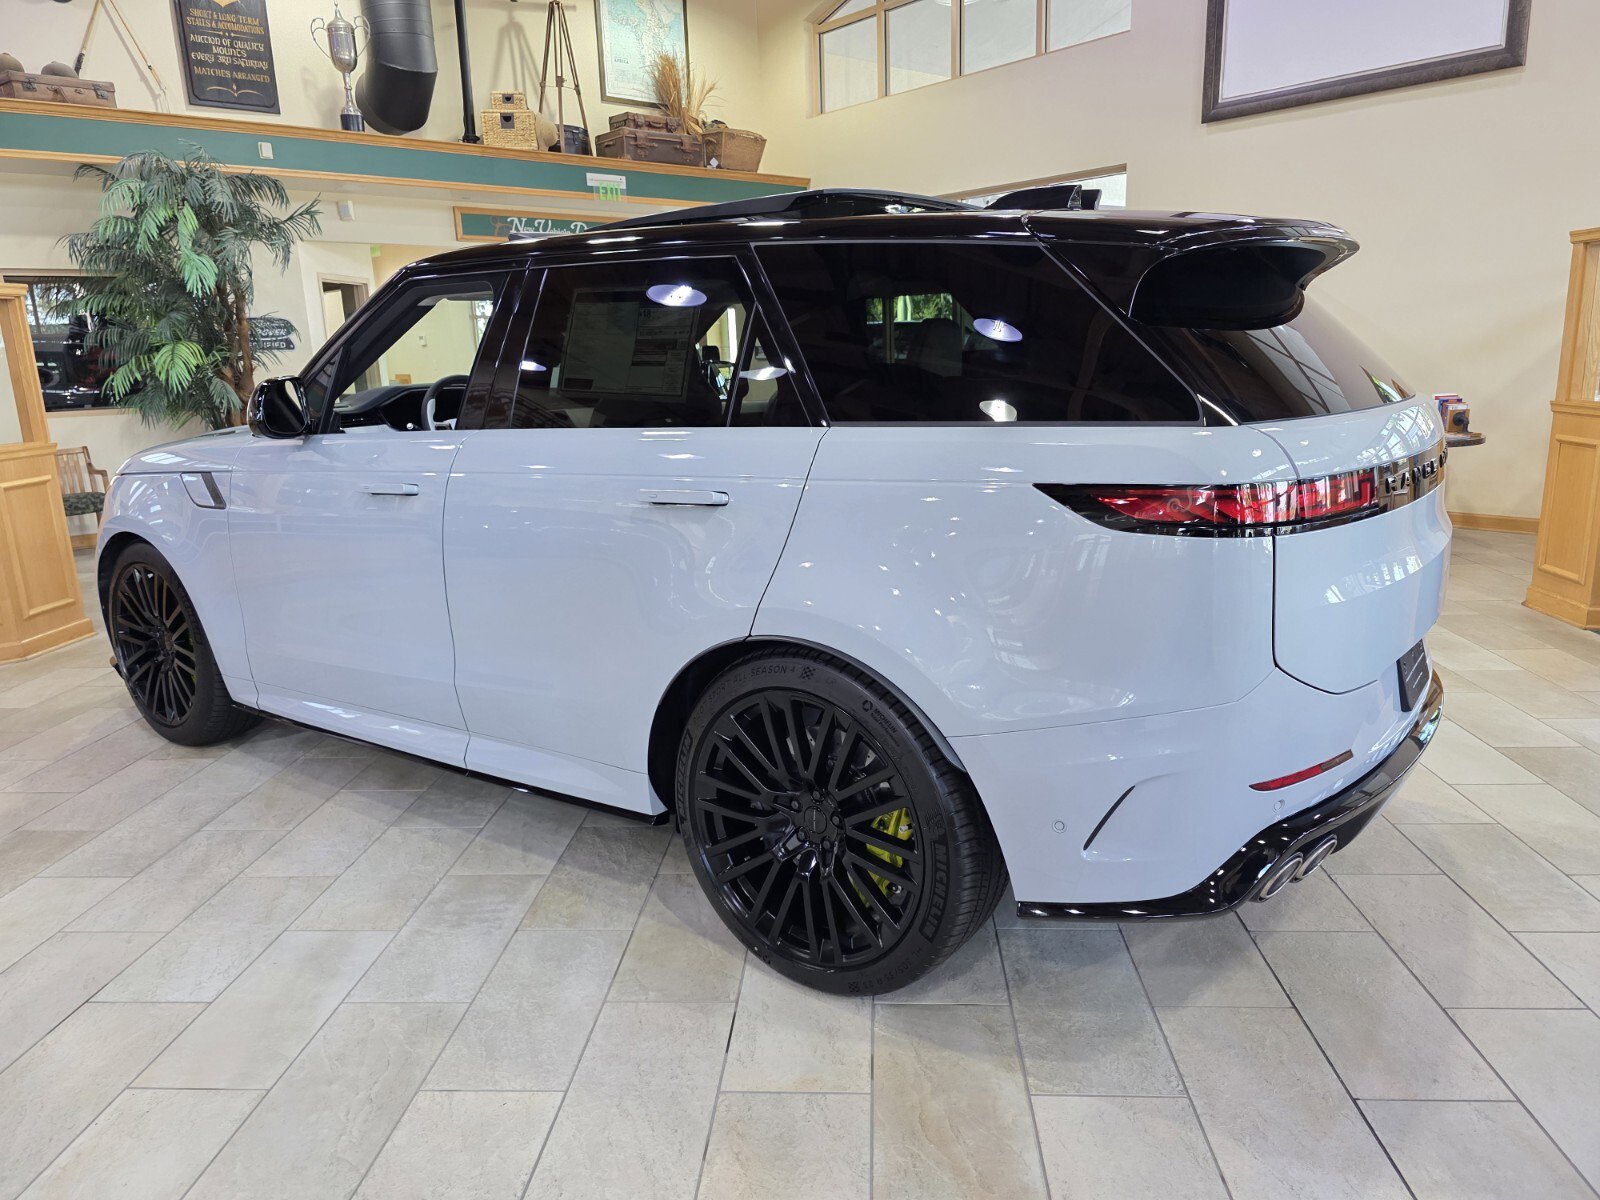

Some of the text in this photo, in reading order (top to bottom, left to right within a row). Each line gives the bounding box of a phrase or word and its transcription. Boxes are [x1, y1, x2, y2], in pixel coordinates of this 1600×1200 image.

[186, 16, 211, 27] STALLS
[190, 8, 211, 19] SHORT
[217, 12, 235, 21] LONG
[239, 15, 259, 26] TERM
[190, 34, 264, 51] AUCTION OF QUALITY
[212, 46, 246, 57] MOUNTS
[191, 52, 269, 70] EVERY 3RD SATURDAY
[194, 66, 270, 83] MATCHES ARRANGED
[599, 182, 621, 201] EXIT
[750, 665, 788, 677] SEASON
[873, 708, 898, 733] MICHELIN
[677, 733, 691, 818] MICHELIN
[922, 842, 948, 938] MICHELIN
